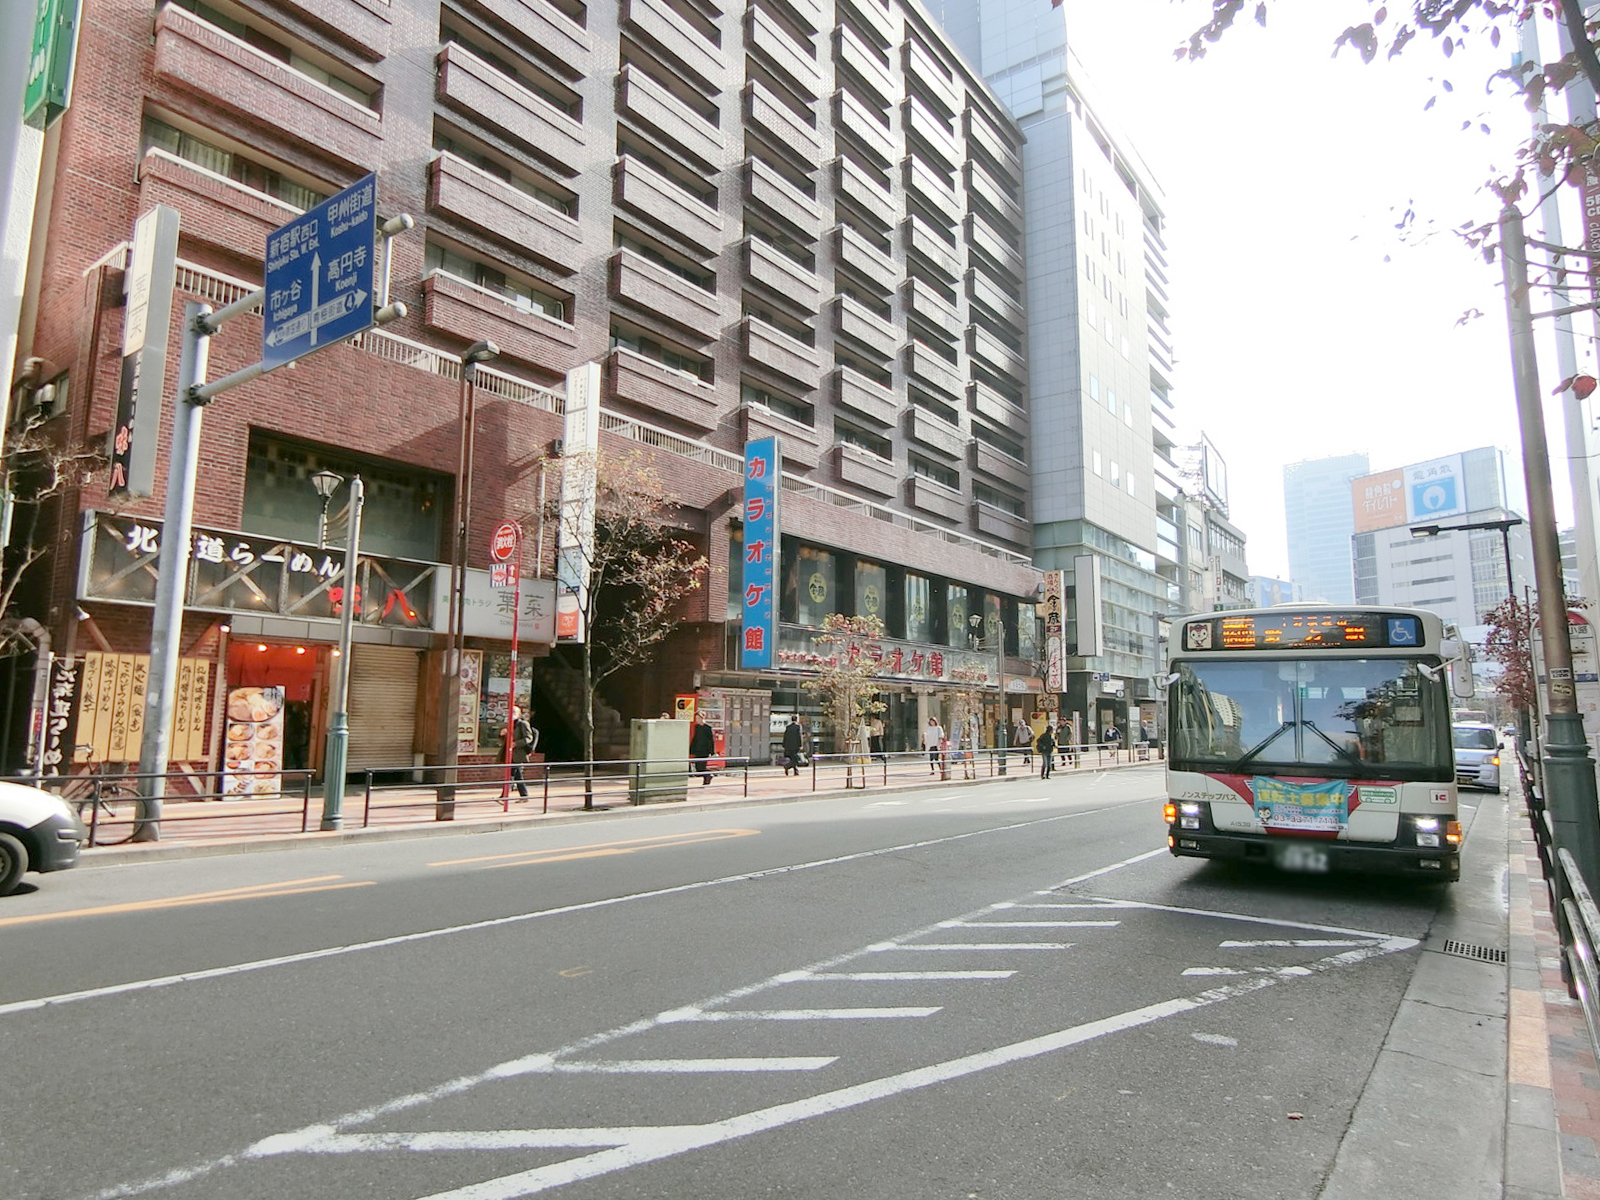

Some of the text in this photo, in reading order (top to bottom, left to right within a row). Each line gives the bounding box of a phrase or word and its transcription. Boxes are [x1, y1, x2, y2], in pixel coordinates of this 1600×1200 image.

[327, 184, 374, 225] 甲州街道
[269, 219, 319, 259] 新宿駅西口
[327, 245, 367, 283] 高円寺
[335, 272, 358, 292] Koenji
[126, 524, 341, 577] 北道らーめん
[744, 457, 766, 650] カラオケ館
[1181, 791, 1238, 801] ノンステップバス
